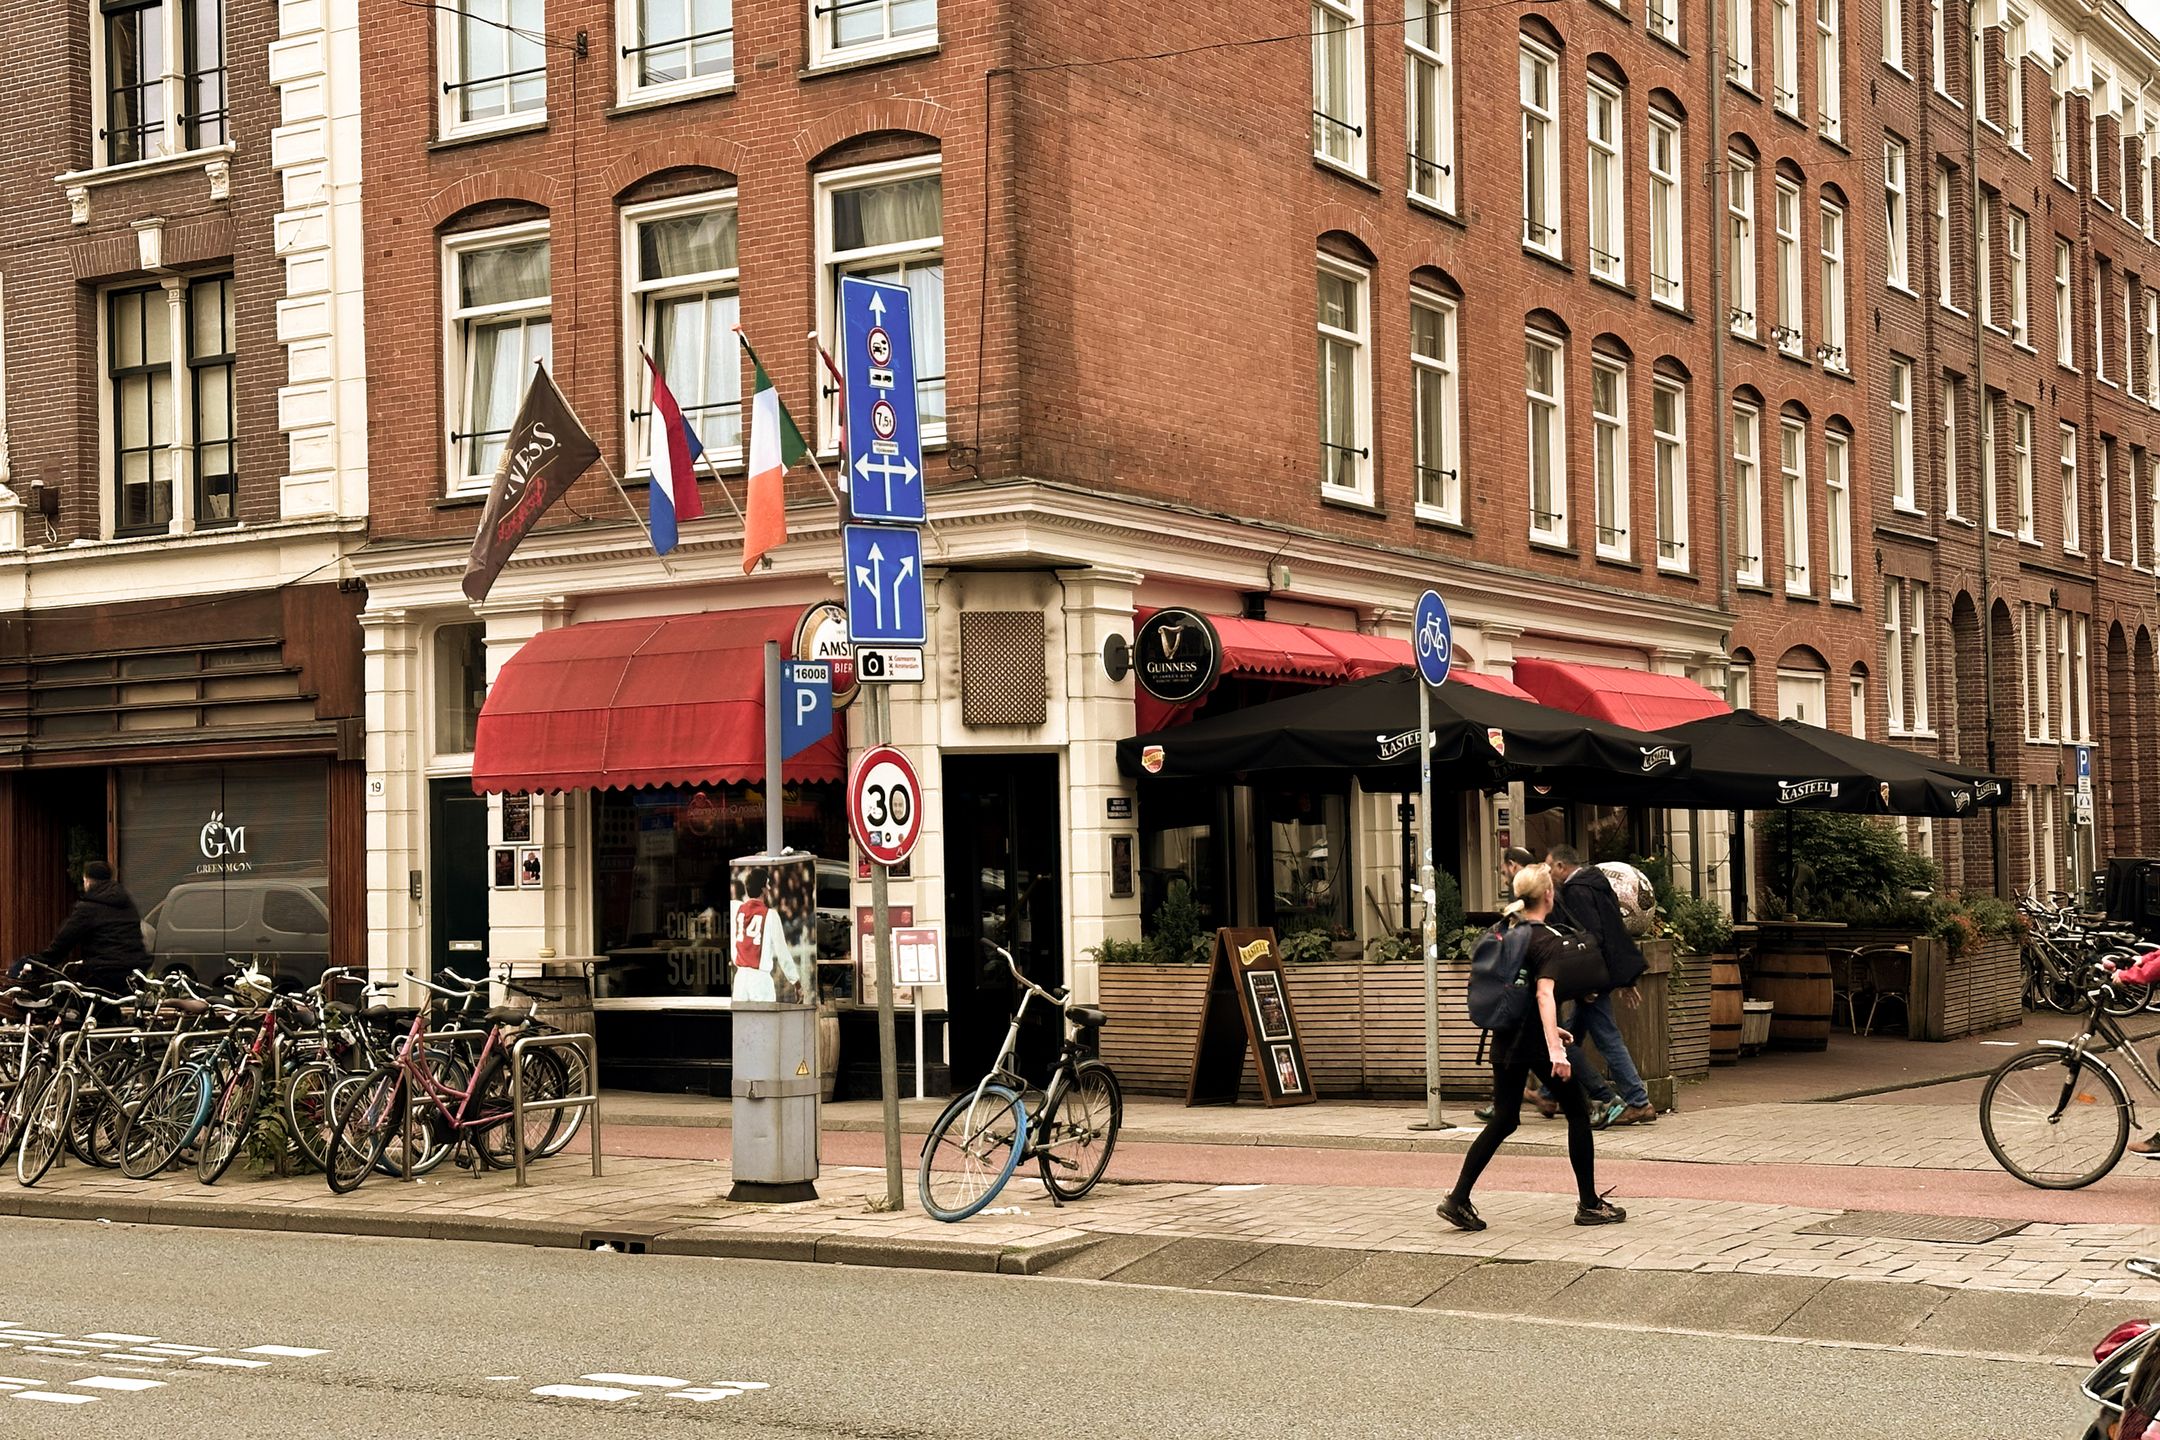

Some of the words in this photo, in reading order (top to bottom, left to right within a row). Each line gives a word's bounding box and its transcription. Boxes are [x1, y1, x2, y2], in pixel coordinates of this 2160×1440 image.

[795, 668, 827, 679] 16008
[834, 662, 853, 673] BIER
[1146, 661, 1197, 673] GUINNESS
[796, 688, 817, 726] P
[1380, 731, 1422, 757] KASTEE
[2079, 751, 2088, 773] P
[371, 781, 382, 793] 19
[1781, 781, 1831, 800] KASTEEL
[867, 783, 911, 827] 30
[200, 817, 247, 859] GM
[736, 912, 764, 946] 14
[667, 949, 731, 986] SCHA
